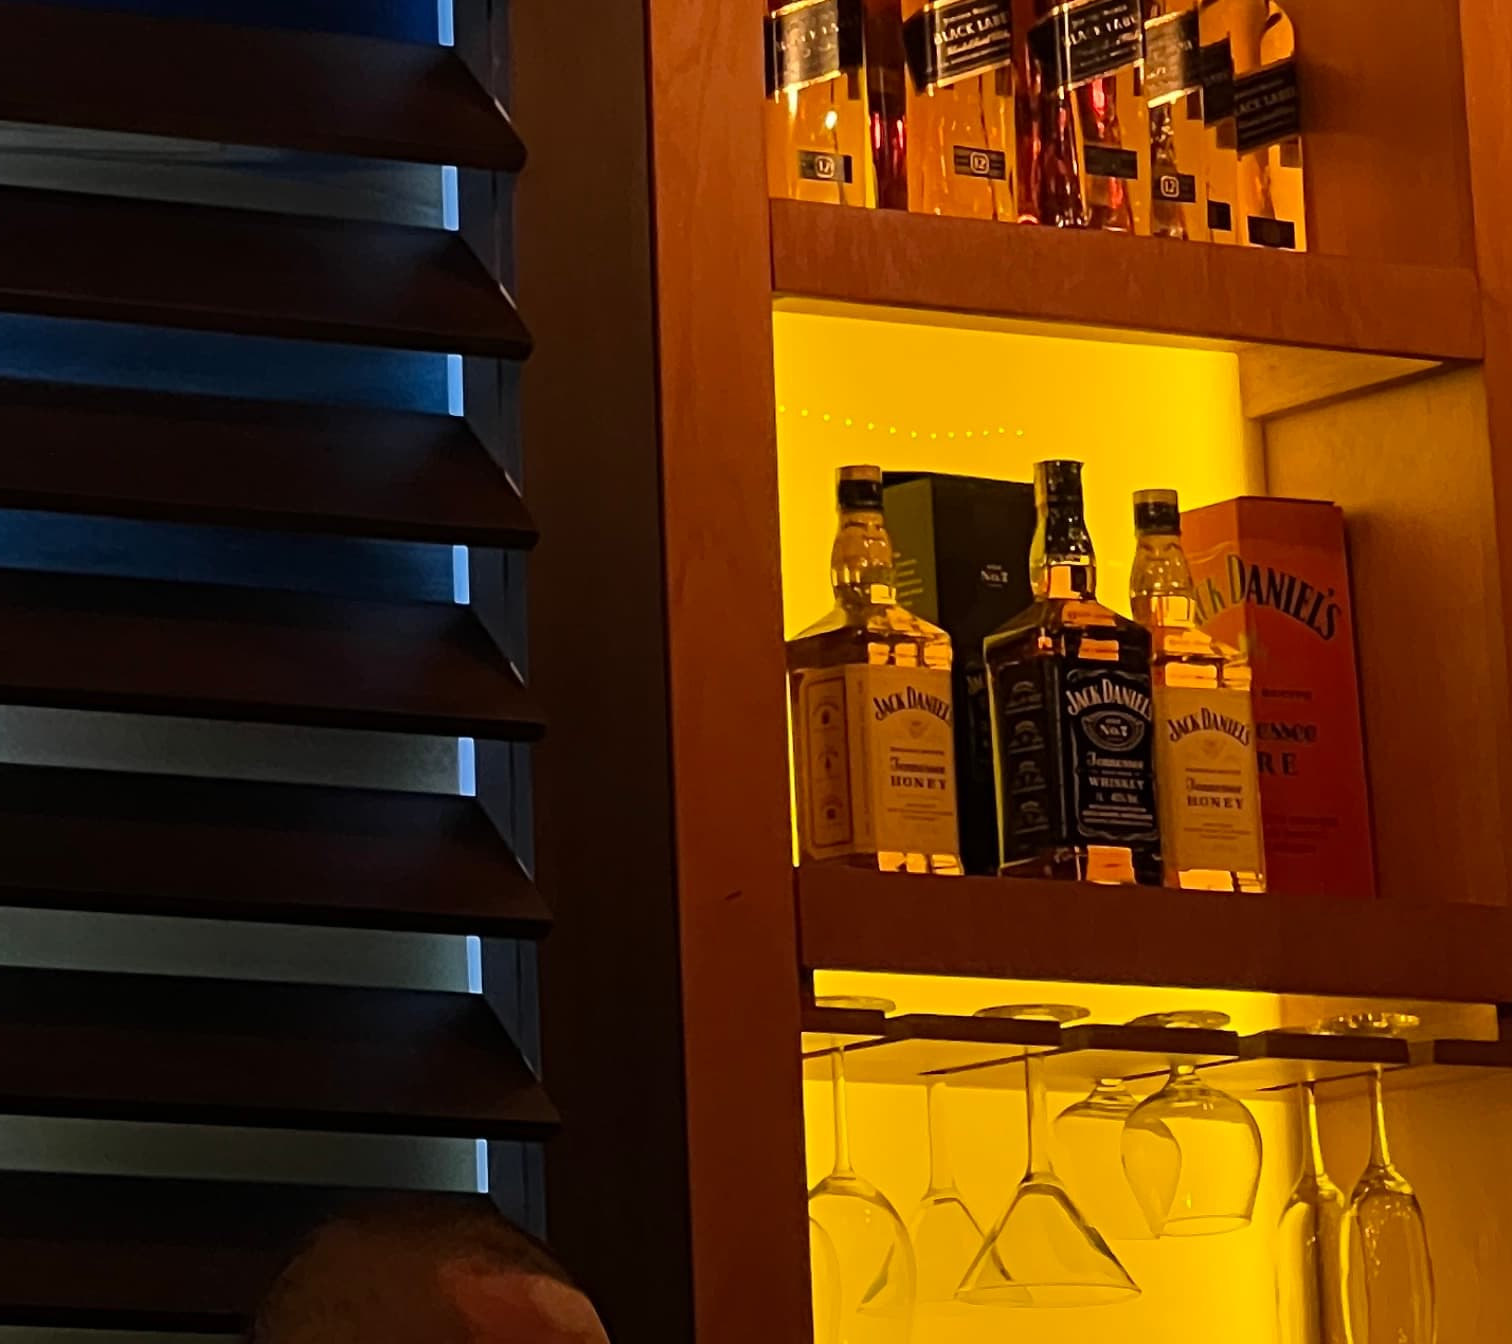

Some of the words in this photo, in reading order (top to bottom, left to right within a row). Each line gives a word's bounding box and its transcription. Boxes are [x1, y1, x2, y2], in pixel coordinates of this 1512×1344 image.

[1226, 554, 1343, 640] DANIEL'S
[873, 693, 906, 721] JACK
[1065, 684, 1101, 716] JACK
[1167, 714, 1201, 742] JACK
[1257, 751, 1299, 776] RE
[890, 775, 947, 791] HONEY
[1187, 794, 1244, 810] HONEY
